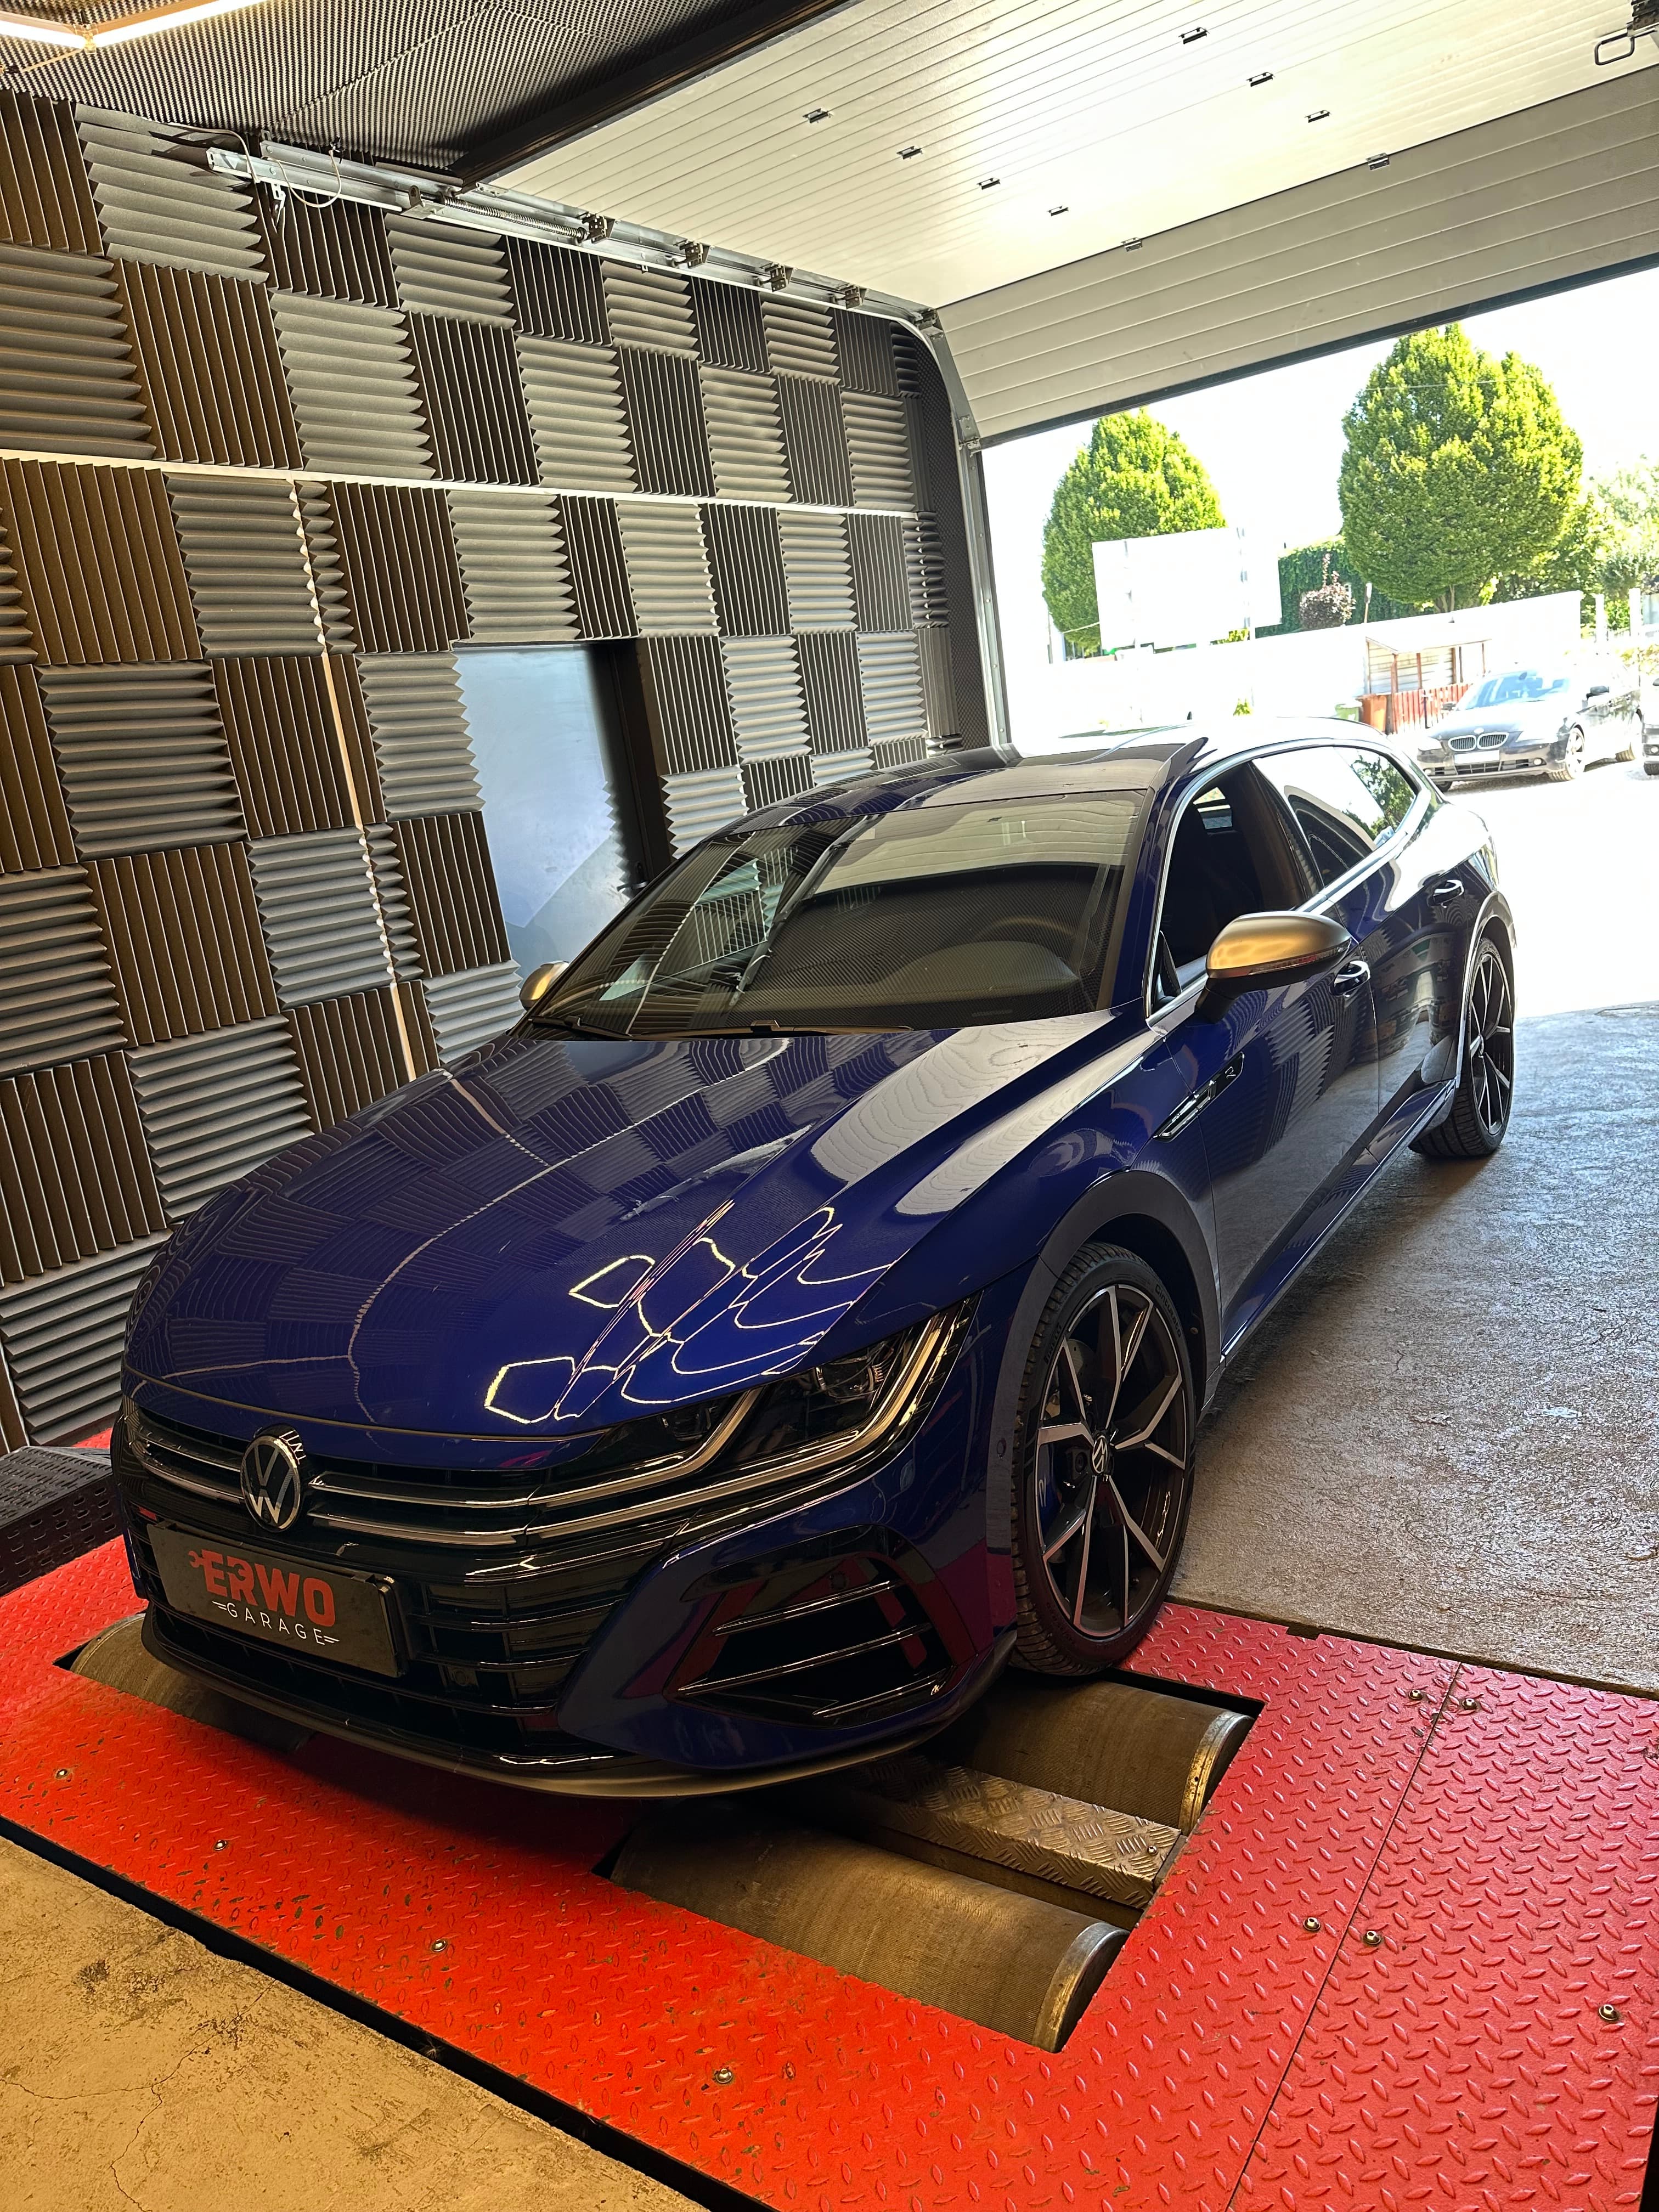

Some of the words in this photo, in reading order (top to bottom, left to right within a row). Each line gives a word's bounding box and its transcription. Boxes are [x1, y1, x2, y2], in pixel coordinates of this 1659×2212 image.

[1155, 1283, 1182, 1338] Cinturato
[201, 1549, 335, 1627] ERWO
[227, 1603, 325, 1645] GARAGE
